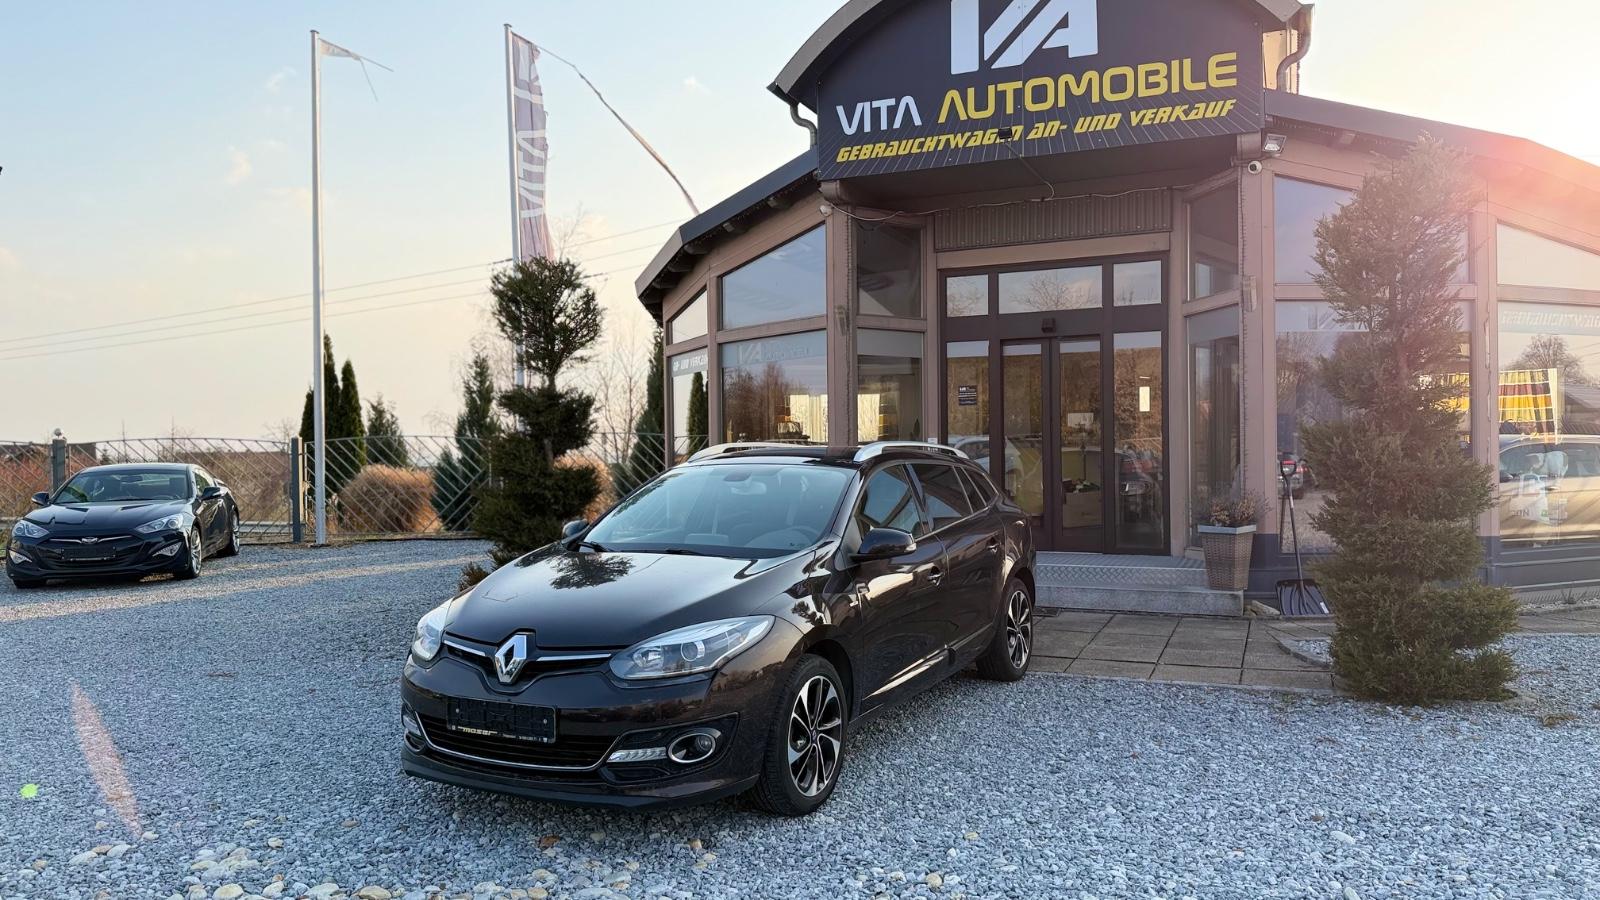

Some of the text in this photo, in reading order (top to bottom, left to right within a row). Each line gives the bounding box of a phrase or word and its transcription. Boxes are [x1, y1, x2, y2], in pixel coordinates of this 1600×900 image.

[836, 52, 1237, 135] VITA AUTOMOBILE
[1026, 120, 1068, 140] AN-
[1073, 112, 1122, 134] UND
[1130, 99, 1237, 127] VERKAUF
